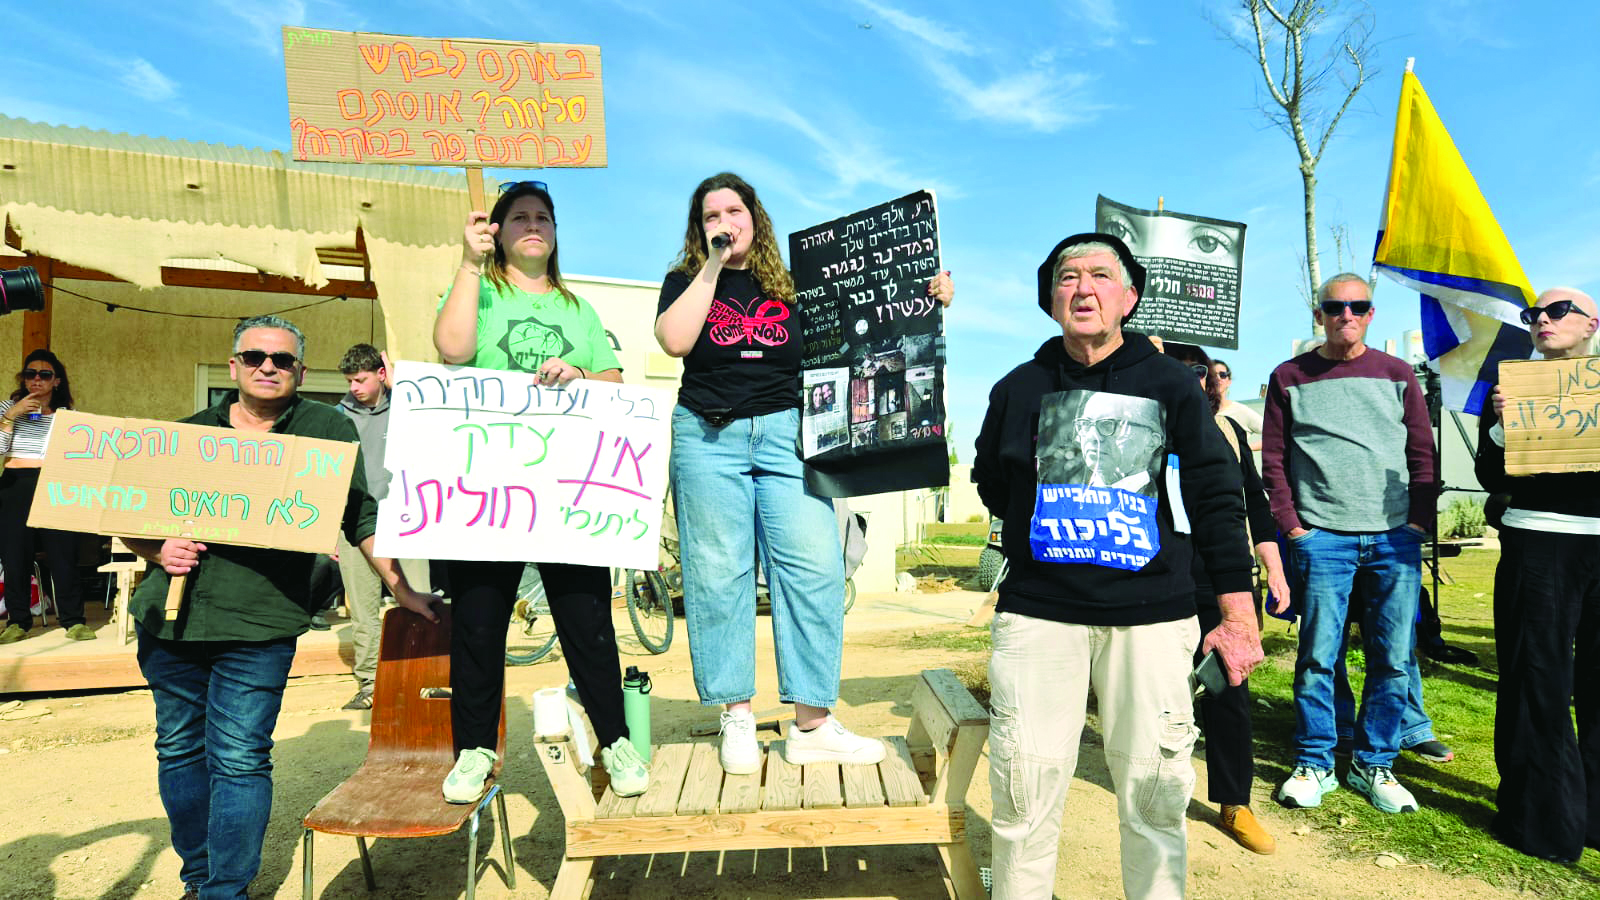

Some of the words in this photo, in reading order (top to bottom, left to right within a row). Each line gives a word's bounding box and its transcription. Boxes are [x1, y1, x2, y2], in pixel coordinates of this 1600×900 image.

[288, 29, 332, 48] חולית
[359, 39, 467, 83] לבקש
[477, 48, 594, 92] באתם
[472, 88, 587, 131] סליחה?
[291, 118, 415, 162] במקרה?
[423, 130, 467, 160] פה
[475, 132, 592, 165] עברתם
[882, 204, 905, 229] אלף
[912, 218, 934, 239] איך
[800, 228, 835, 251] אזהרה
[840, 236, 864, 258] שלך
[869, 225, 911, 247] בידיים
[873, 237, 934, 265] המדינה
[822, 256, 865, 279] נגמרה
[896, 257, 936, 278] השקרן
[832, 274, 865, 297] ממשיך
[848, 289, 875, 310] כבר,
[881, 278, 898, 302] לך
[1151, 276, 1181, 295] חללי
[875, 296, 936, 323] עכשיו!
[712, 323, 745, 342] HOME
[753, 323, 787, 342] NOW
[396, 375, 504, 420] חקירה
[513, 383, 589, 417] ועדת
[610, 388, 660, 421] בלי
[63, 424, 179, 460] והכאב
[199, 434, 285, 466] ההרס
[453, 423, 555, 475] צדק
[294, 447, 345, 478] את
[573, 430, 652, 506] אין
[47, 481, 148, 512] מהאוטו
[169, 487, 250, 521] רואים
[266, 489, 321, 529] לא
[399, 469, 537, 537] חולית!
[1042, 487, 1112, 505] מתבייש
[1117, 489, 1148, 514] בגין
[560, 505, 649, 541] ליתומי
[1040, 511, 1152, 551] בליכוד
